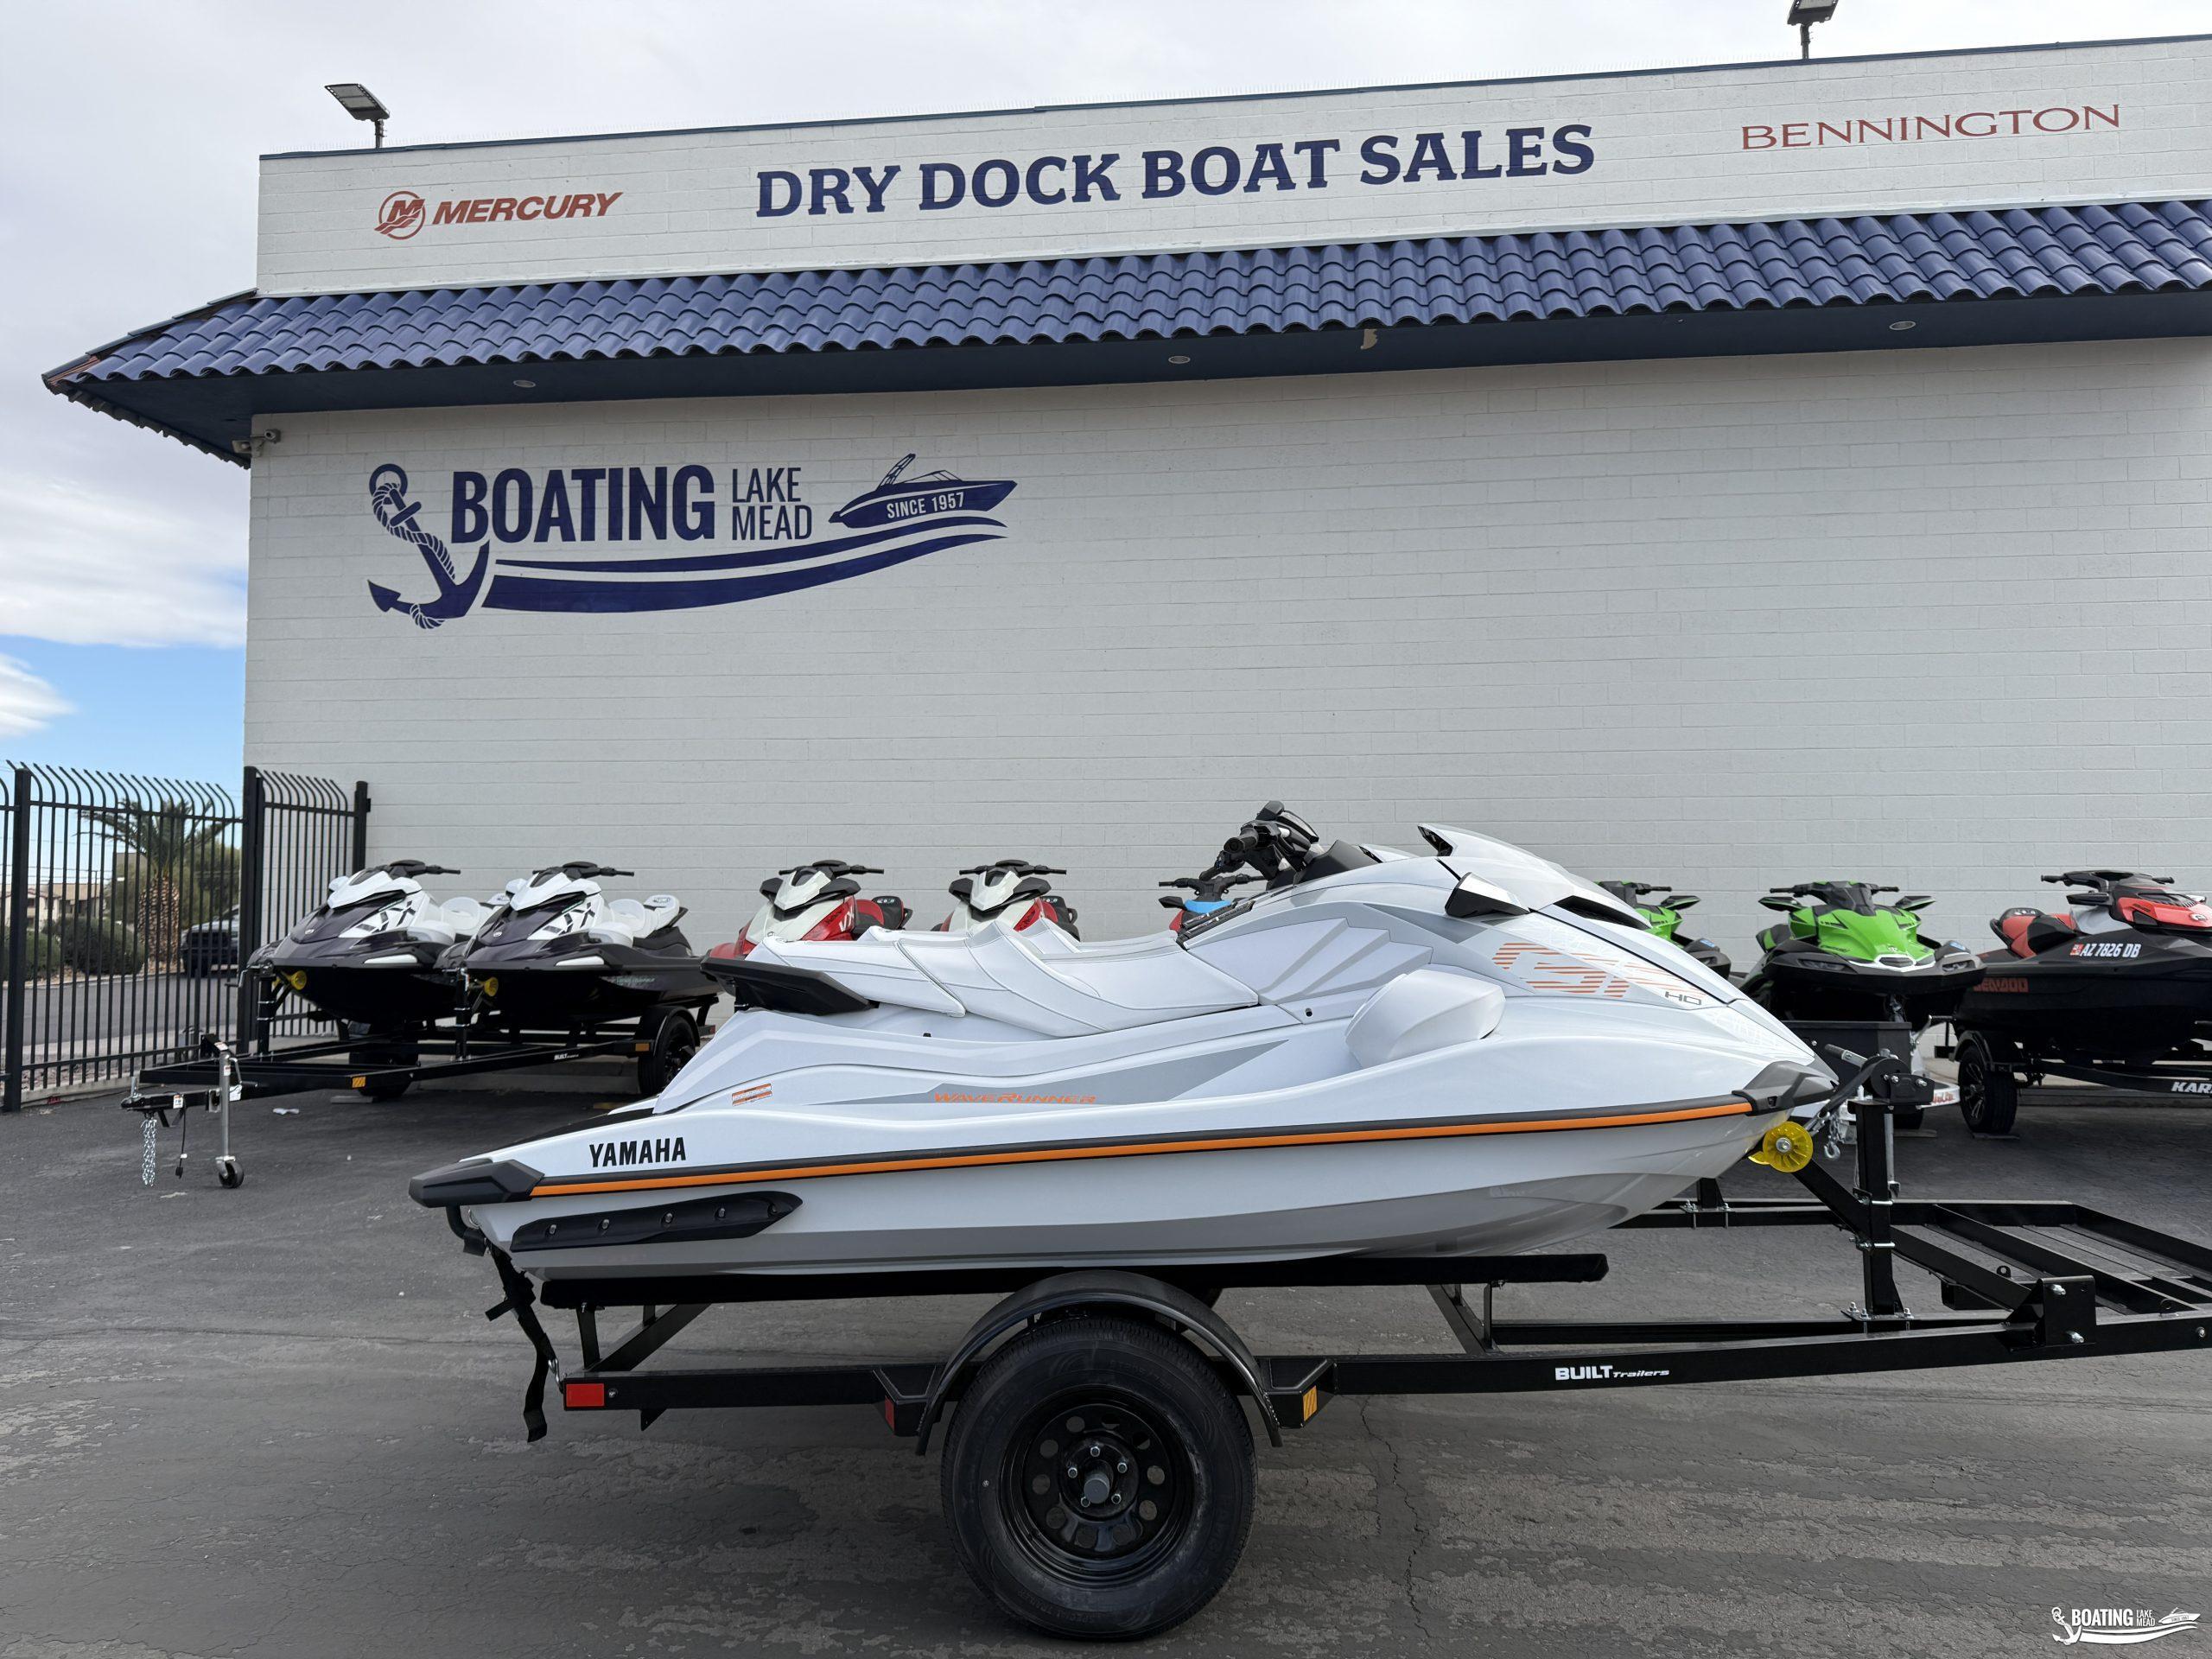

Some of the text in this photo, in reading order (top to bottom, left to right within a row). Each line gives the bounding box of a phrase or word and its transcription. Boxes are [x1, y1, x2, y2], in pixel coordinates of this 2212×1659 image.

[1743, 105, 2120, 150] BENNINGTON
[756, 124, 1595, 218] DRY DOCK BOAT SALES
[432, 192, 624, 225] MERCURY
[731, 467, 803, 503] LAKE
[451, 464, 715, 543] BOATING
[886, 491, 965, 519] SINCE 1957
[731, 505, 813, 541] MEAD
[2080, 943, 2097, 957] AZ
[2094, 943, 2124, 957] 7826
[2122, 943, 2142, 958] DB
[2171, 1081, 2212, 1094] KAR
[588, 1136, 687, 1167] YAMAHA
[1555, 1365, 1670, 1381] BUILT Trailers
